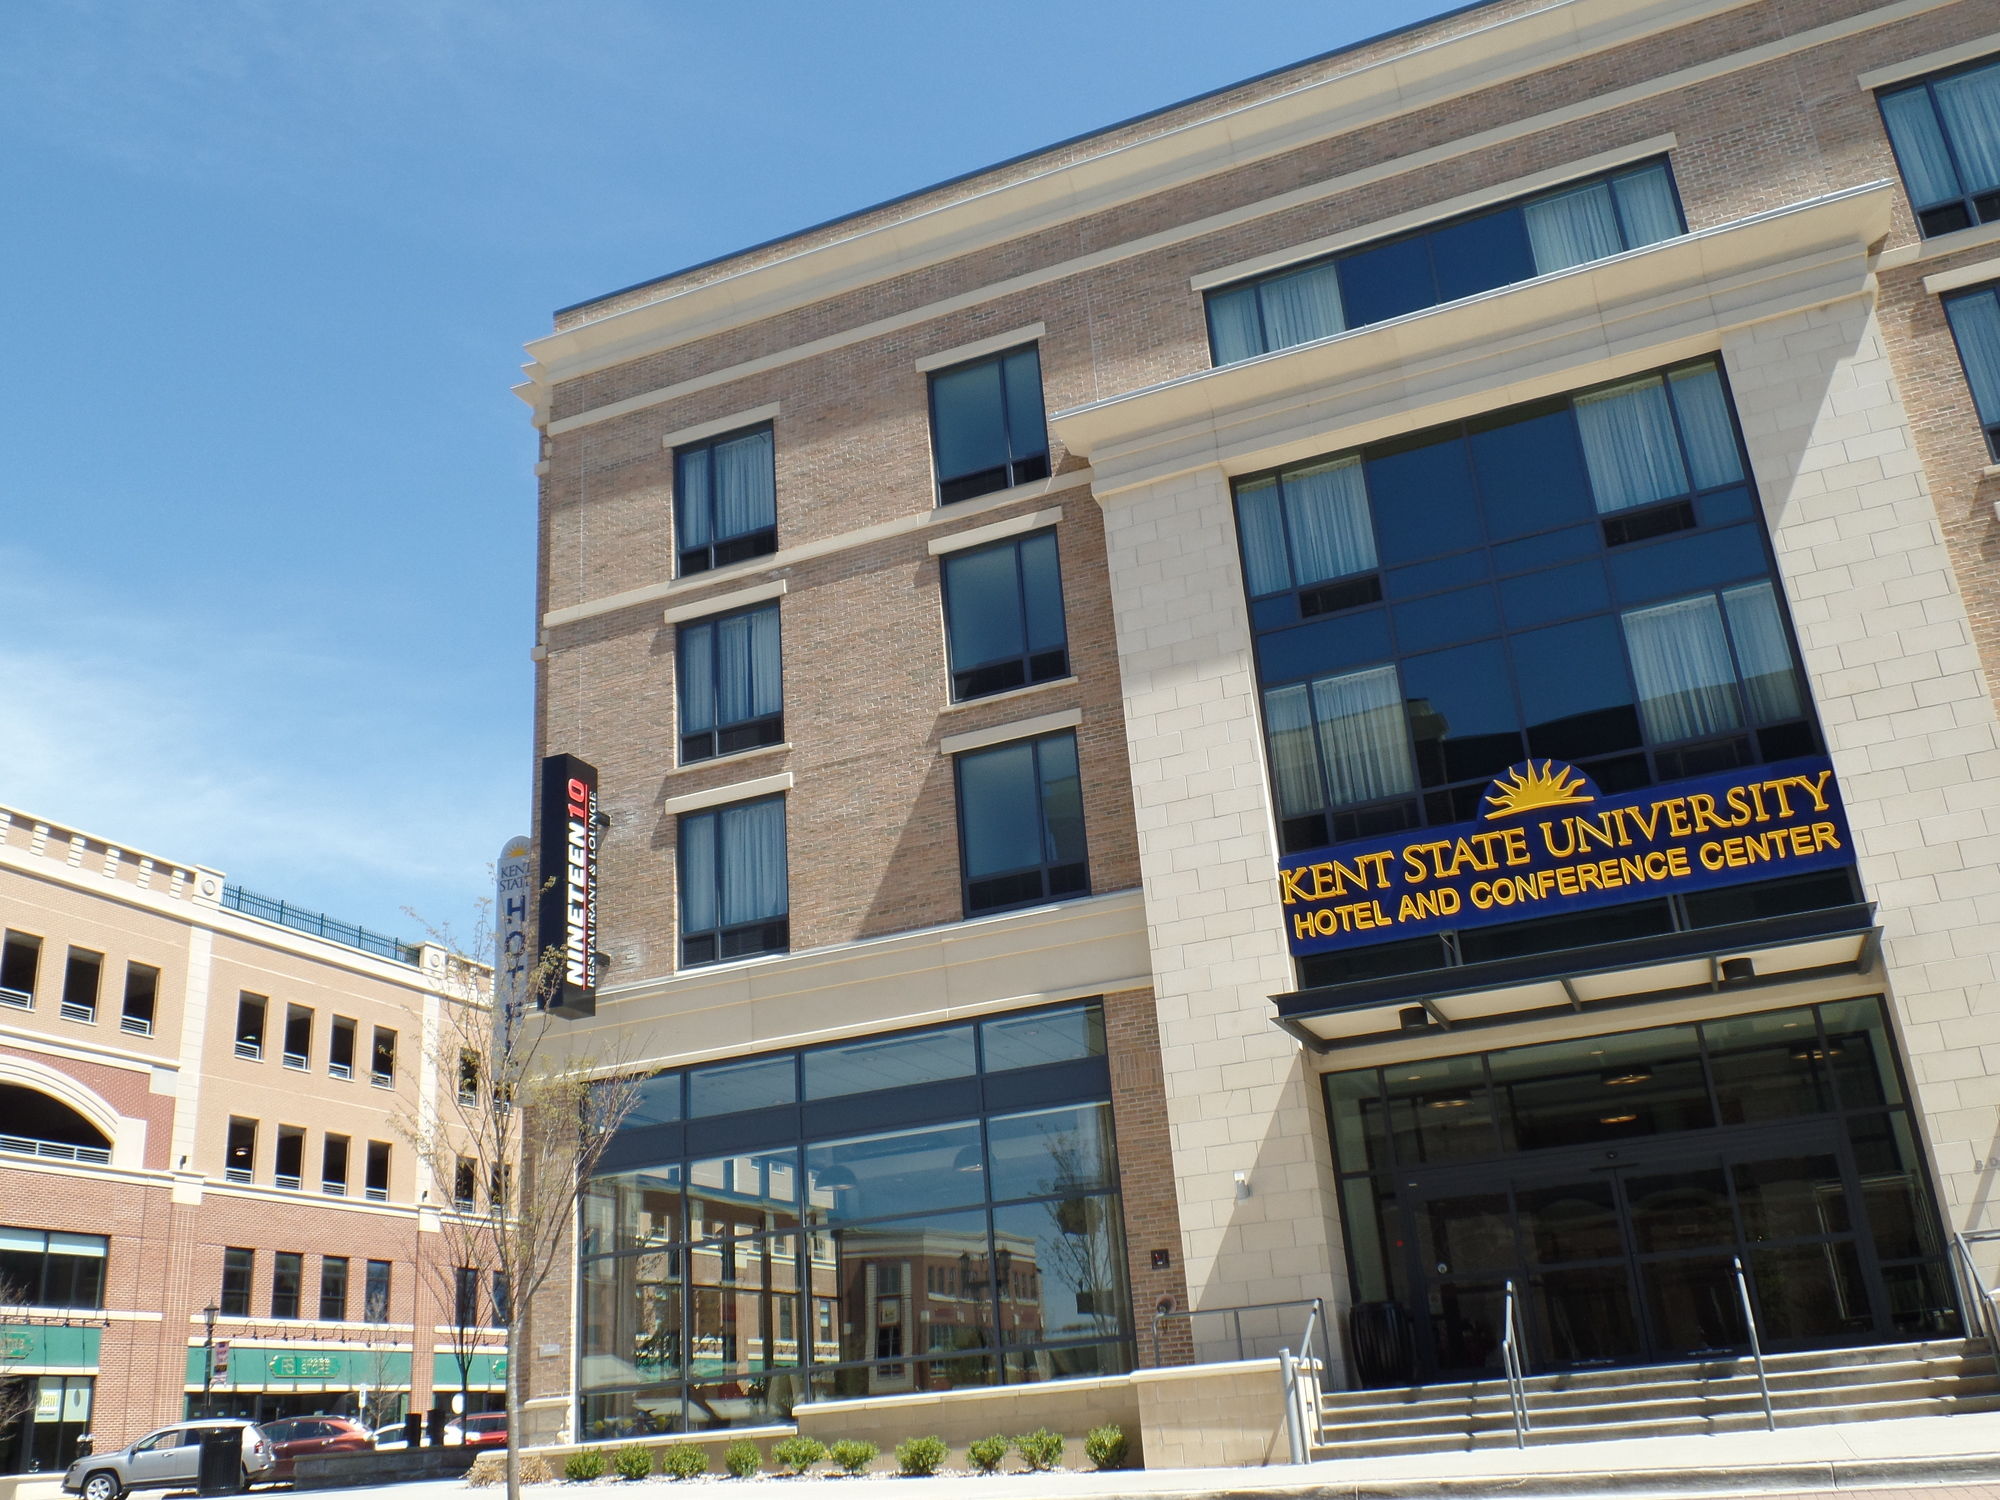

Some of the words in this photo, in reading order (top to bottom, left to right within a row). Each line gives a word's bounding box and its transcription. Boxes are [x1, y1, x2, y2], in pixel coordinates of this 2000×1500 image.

[501, 861, 531, 878] KENT
[588, 791, 598, 860] LOUNGE
[1279, 850, 1396, 905] KENT
[1403, 826, 1531, 884] STATE
[1540, 770, 1833, 858] UNIVERSITY
[587, 879, 598, 987] RESTAURANT
[1294, 900, 1394, 940] HOTEL
[1398, 887, 1462, 922] AND
[1470, 846, 1693, 909] CONFERENCE
[1699, 821, 1842, 871] CENTER
